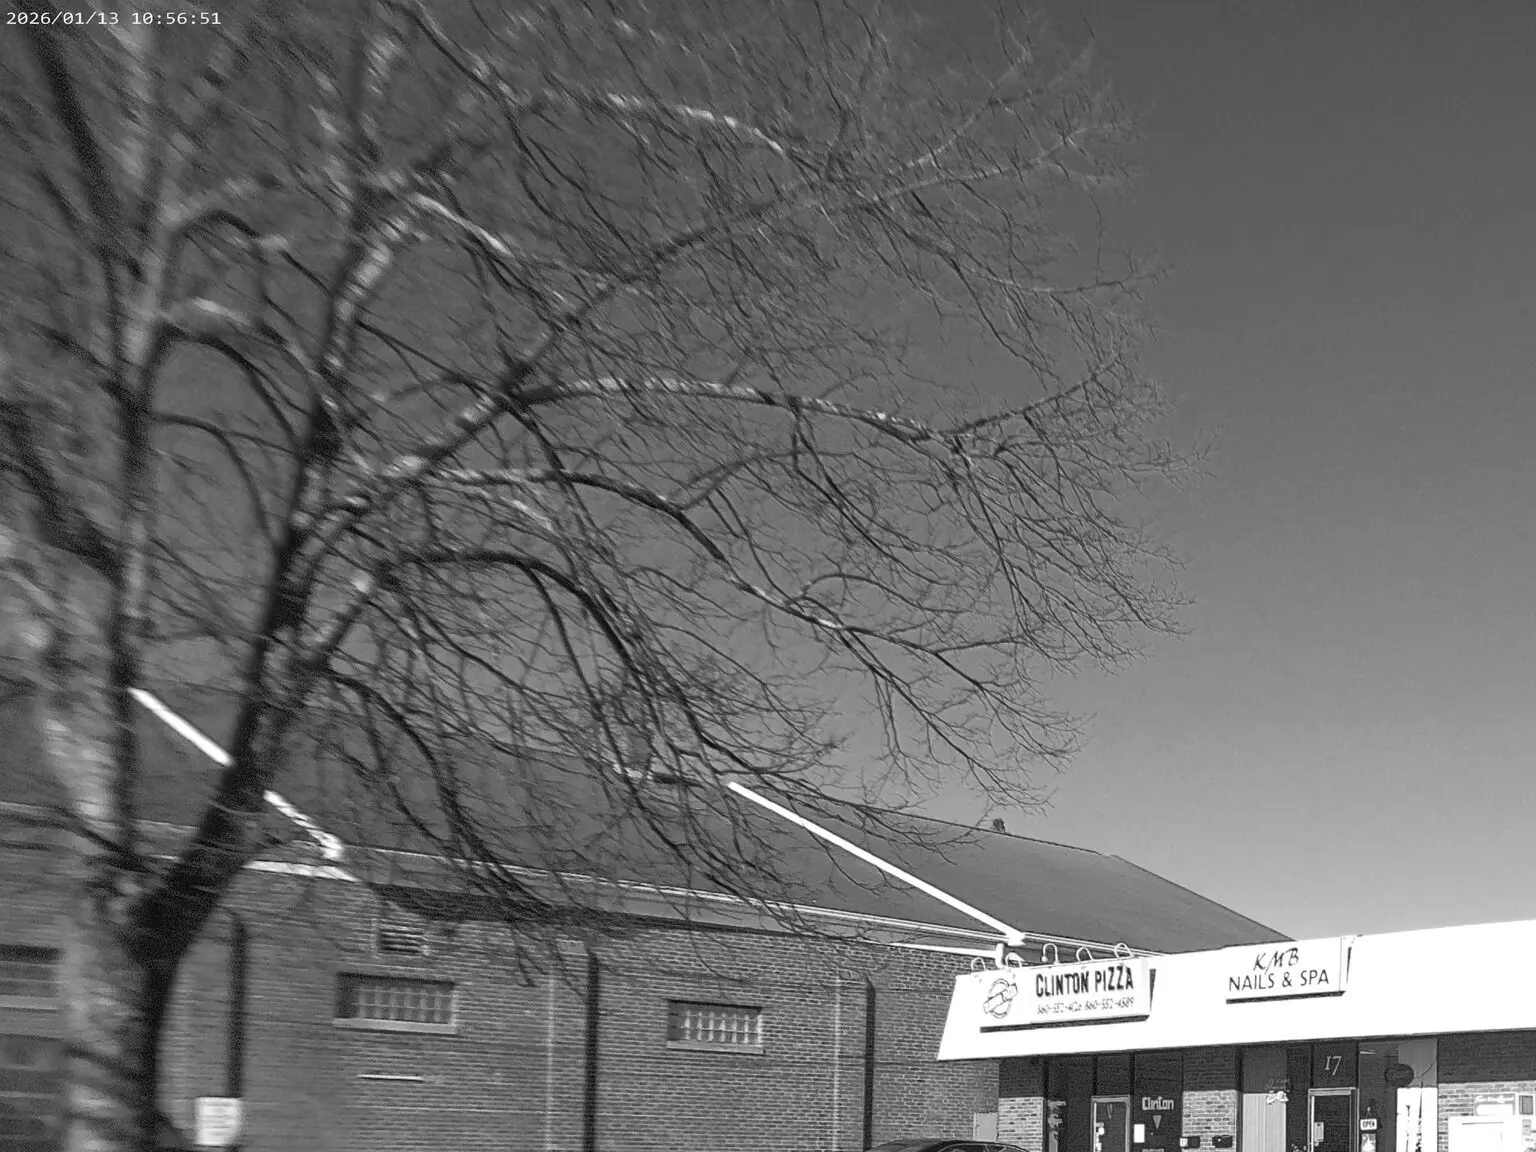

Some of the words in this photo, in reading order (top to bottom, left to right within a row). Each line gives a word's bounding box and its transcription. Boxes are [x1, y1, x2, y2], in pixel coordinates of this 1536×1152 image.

[1253, 947, 1299, 975] KMB
[1035, 970, 1090, 997] CLINTON
[1095, 965, 1134, 993] PIZZA
[1229, 973, 1275, 991] NAILS
[1282, 971, 1292, 987] &
[1300, 969, 1329, 986] SPA
[1325, 1056, 1342, 1076] 17
